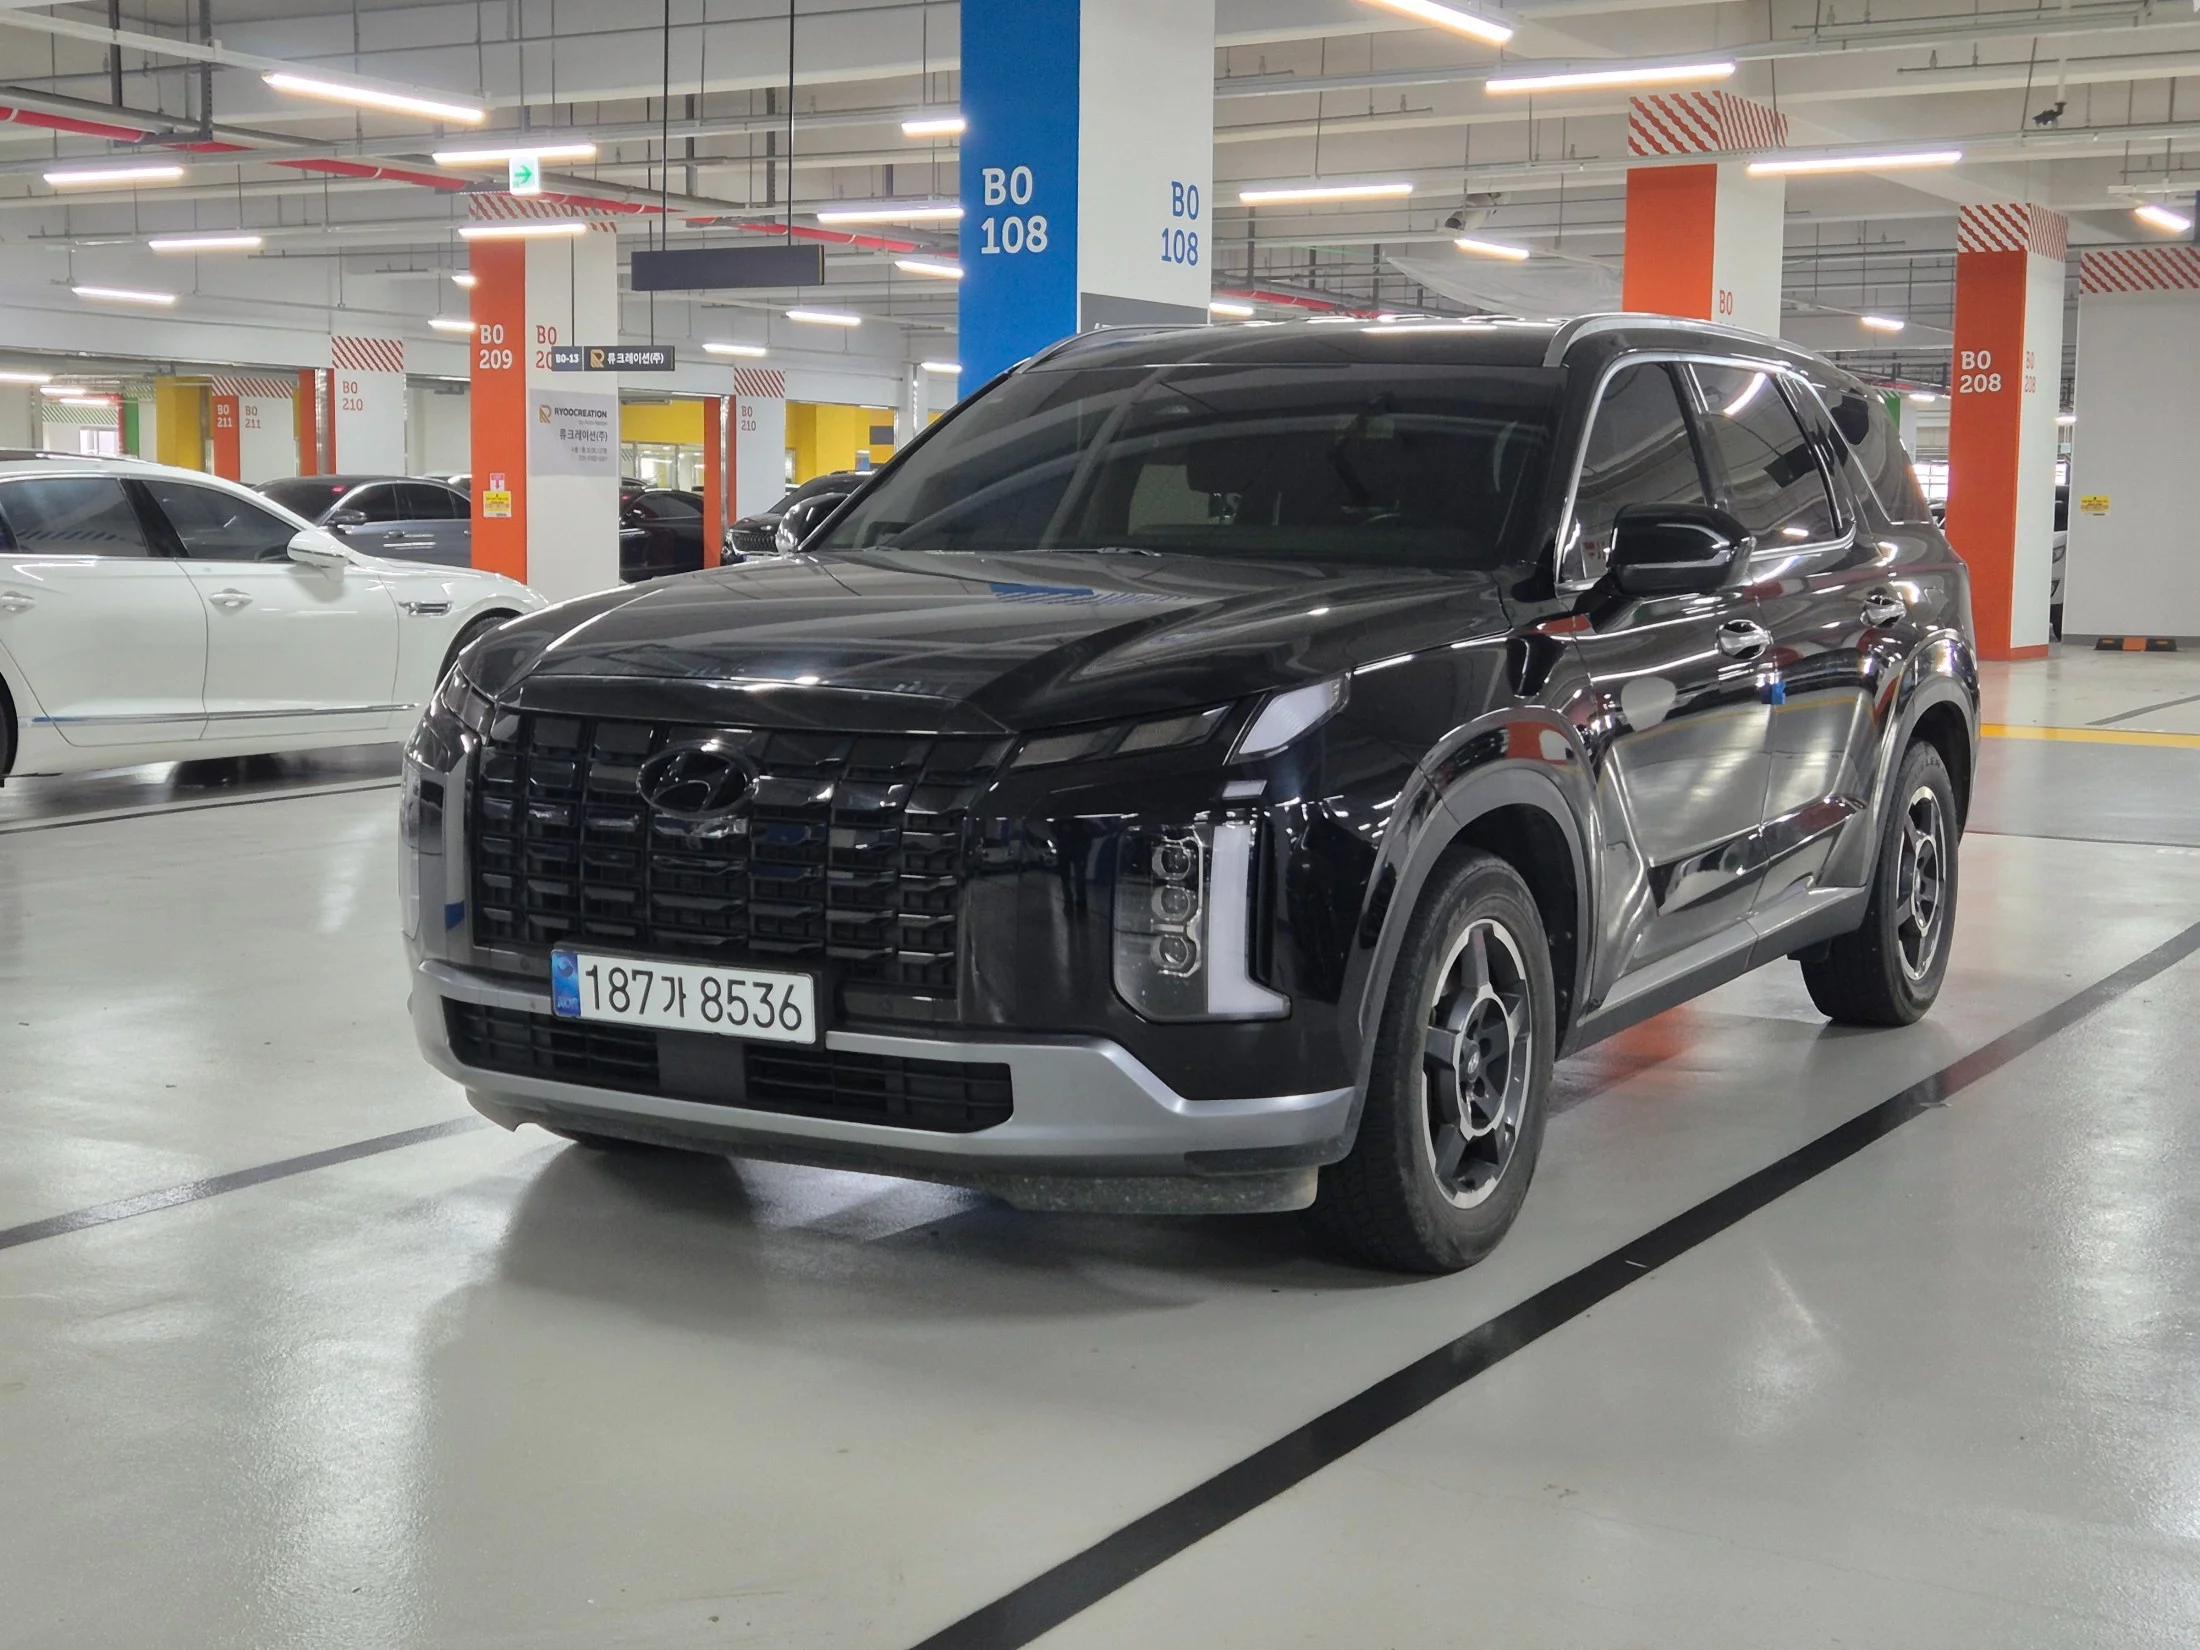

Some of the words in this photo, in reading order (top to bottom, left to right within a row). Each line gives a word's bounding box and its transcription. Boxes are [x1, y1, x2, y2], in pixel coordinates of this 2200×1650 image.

[981, 215, 1048, 254] 108
[1161, 227, 1199, 266] 108
[479, 350, 513, 370] 209
[1959, 373, 2002, 393] 208
[342, 398, 363, 411] 210
[217, 416, 232, 428] 211
[244, 418, 261, 429] 211
[740, 420, 756, 431] 210
[585, 964, 687, 1018] 187가
[699, 976, 802, 1031] 8536
